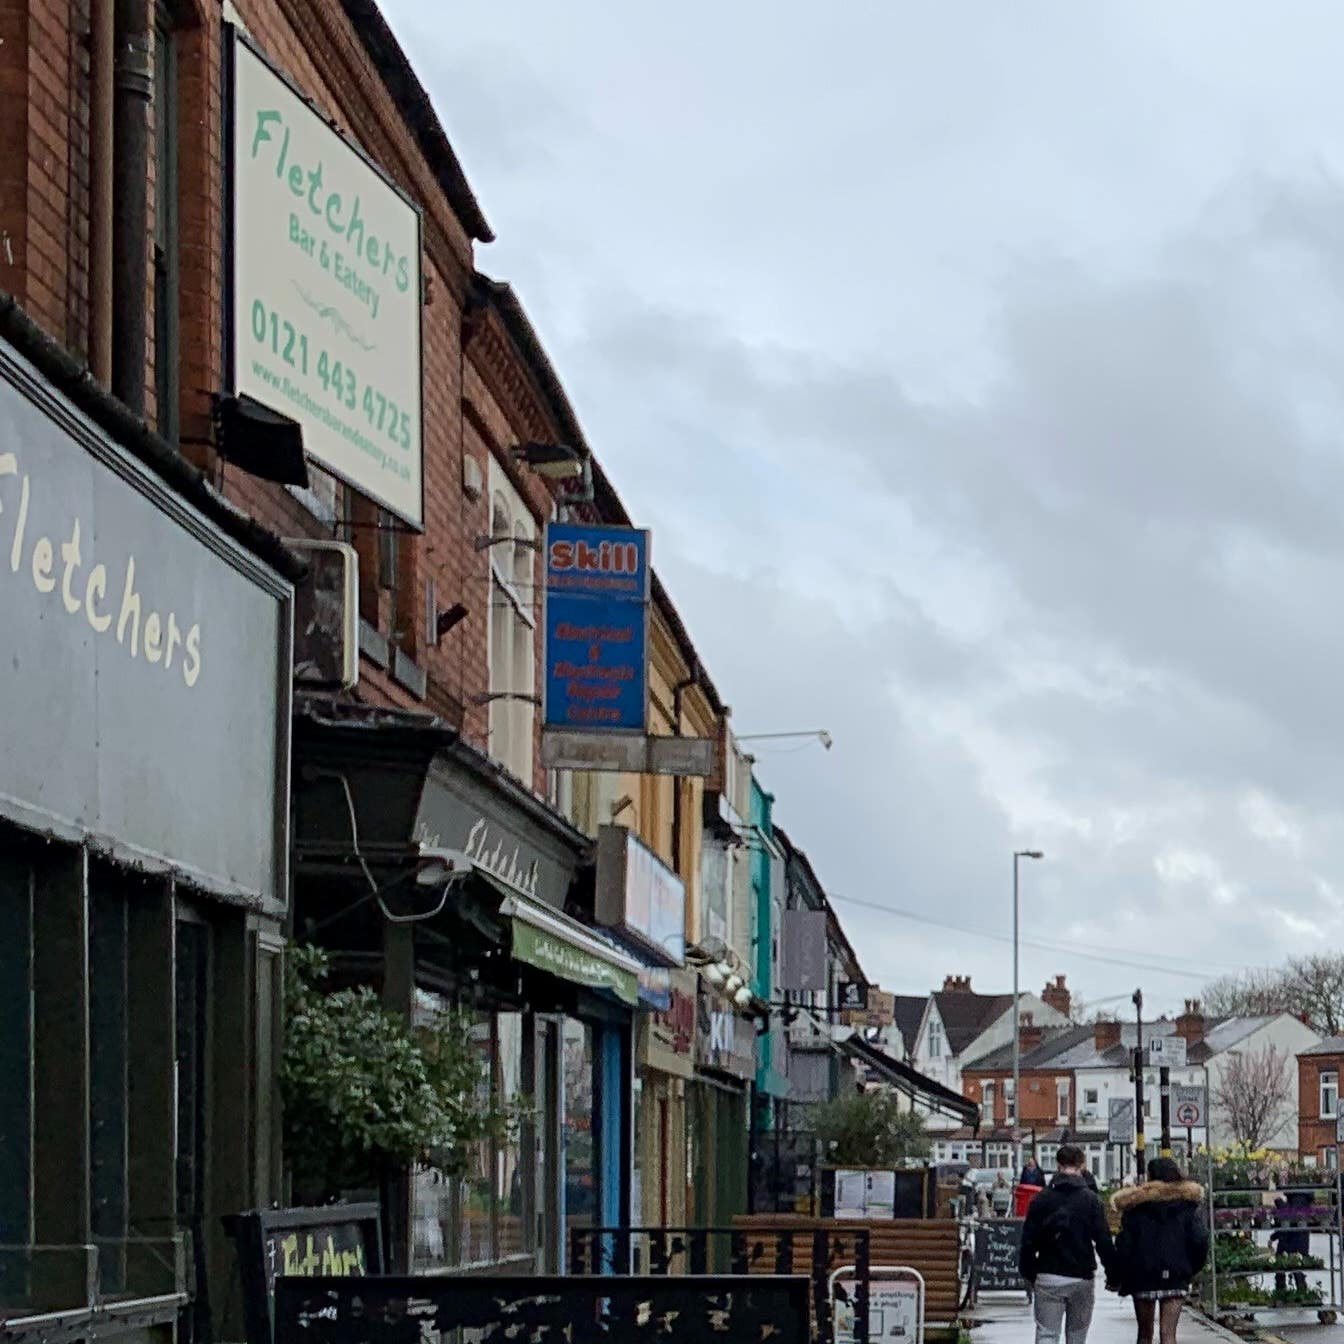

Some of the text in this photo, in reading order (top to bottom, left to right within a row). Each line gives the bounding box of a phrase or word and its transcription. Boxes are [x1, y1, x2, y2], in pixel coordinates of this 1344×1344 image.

[252, 110, 409, 292] Fletchers
[289, 213, 315, 257] Bar
[335, 252, 380, 320] Eatery
[252, 299, 411, 450] 0121 443 4725
[550, 540, 639, 574] Skill
